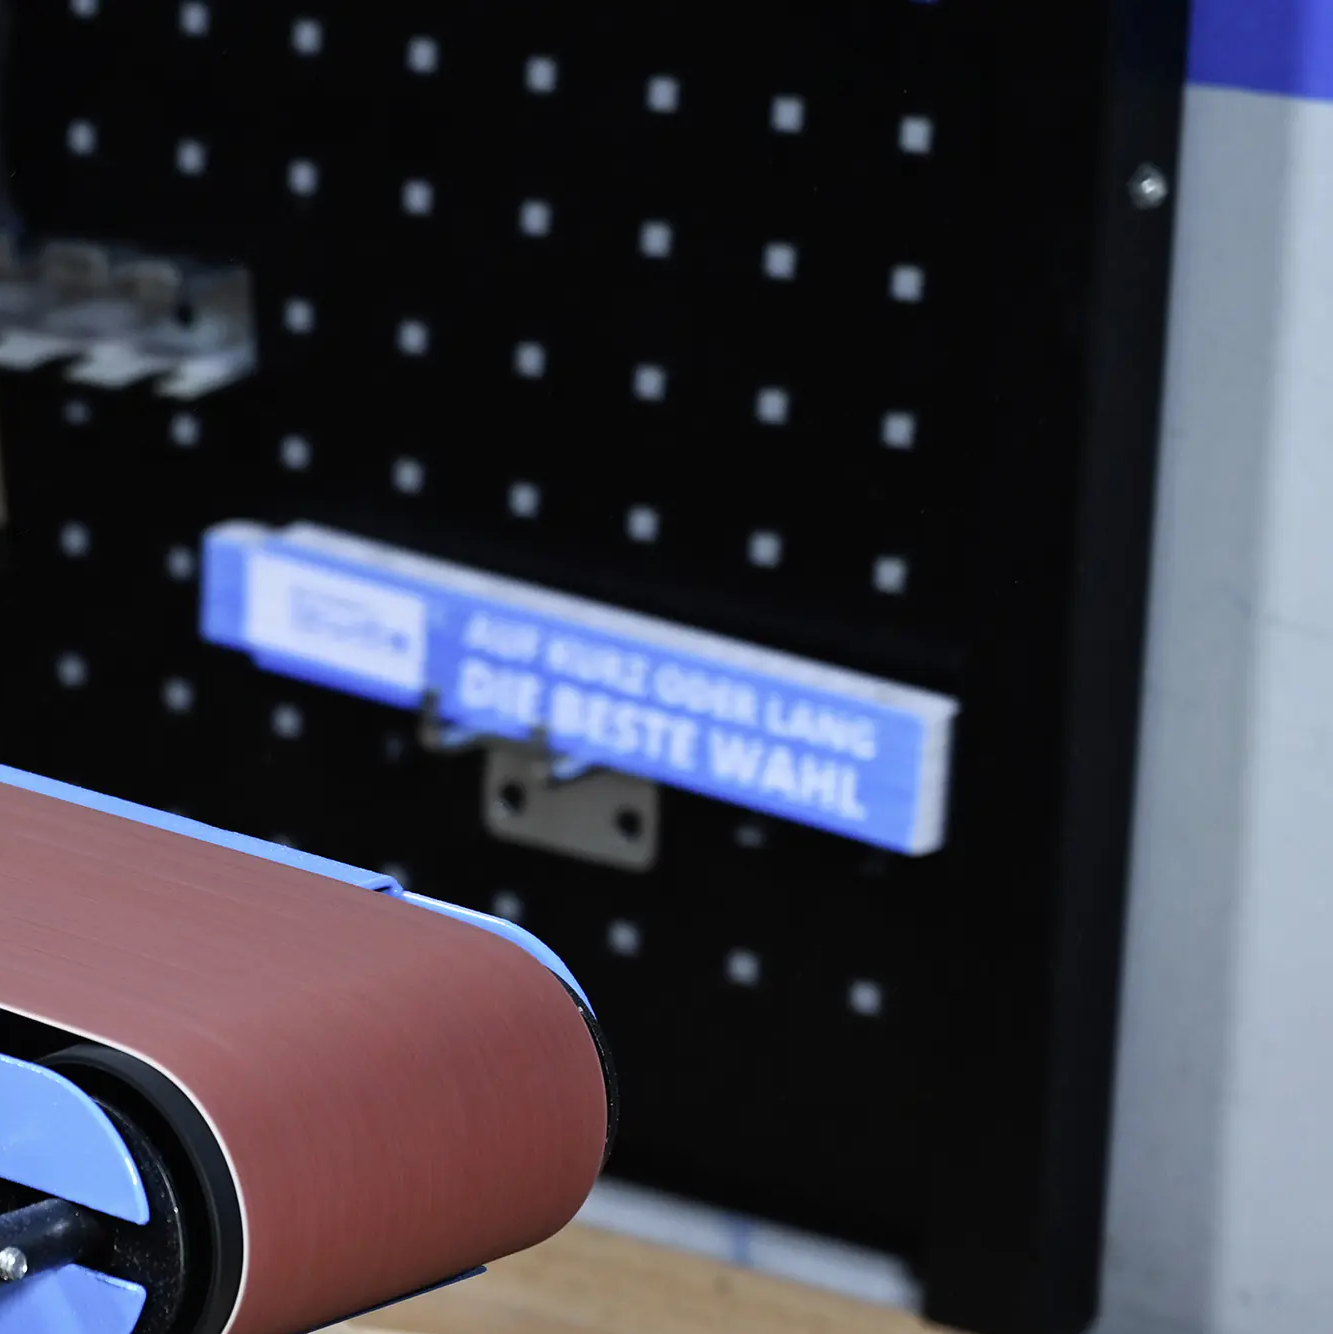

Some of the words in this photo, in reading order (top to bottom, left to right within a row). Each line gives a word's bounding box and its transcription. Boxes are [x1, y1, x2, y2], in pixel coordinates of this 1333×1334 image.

[459, 657, 541, 723] DIE
[549, 683, 699, 771] BESTE
[708, 728, 866, 820] WAHL
[464, 614, 539, 661] AUF
[546, 637, 649, 694] KURZ
[653, 663, 757, 724] ODER
[764, 693, 877, 760] LANG
